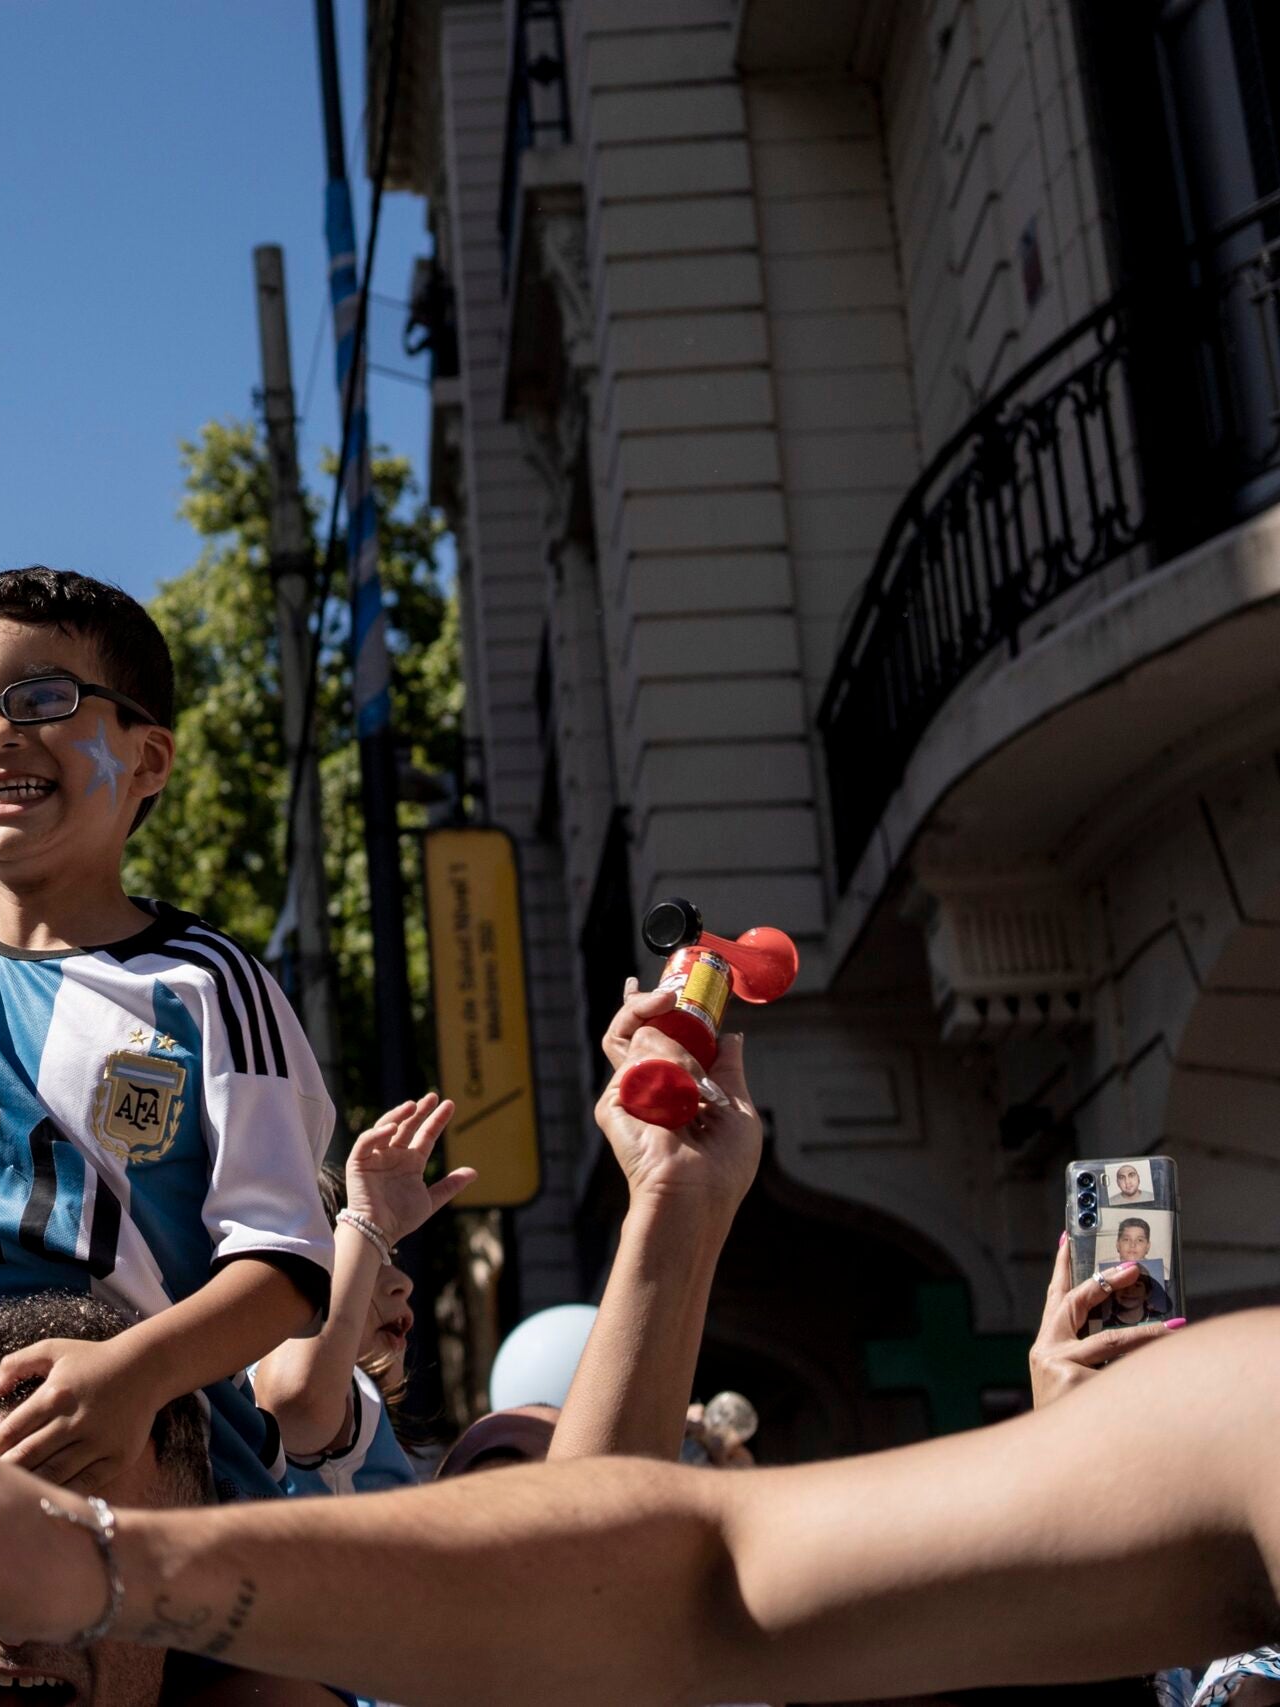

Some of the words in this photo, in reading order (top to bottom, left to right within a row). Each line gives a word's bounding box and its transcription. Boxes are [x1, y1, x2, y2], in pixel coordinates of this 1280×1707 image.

[456, 935, 476, 992] Salud
[462, 999, 476, 1022] de
[463, 1031, 484, 1098] Centro
[114, 1082, 160, 1131] AFA
